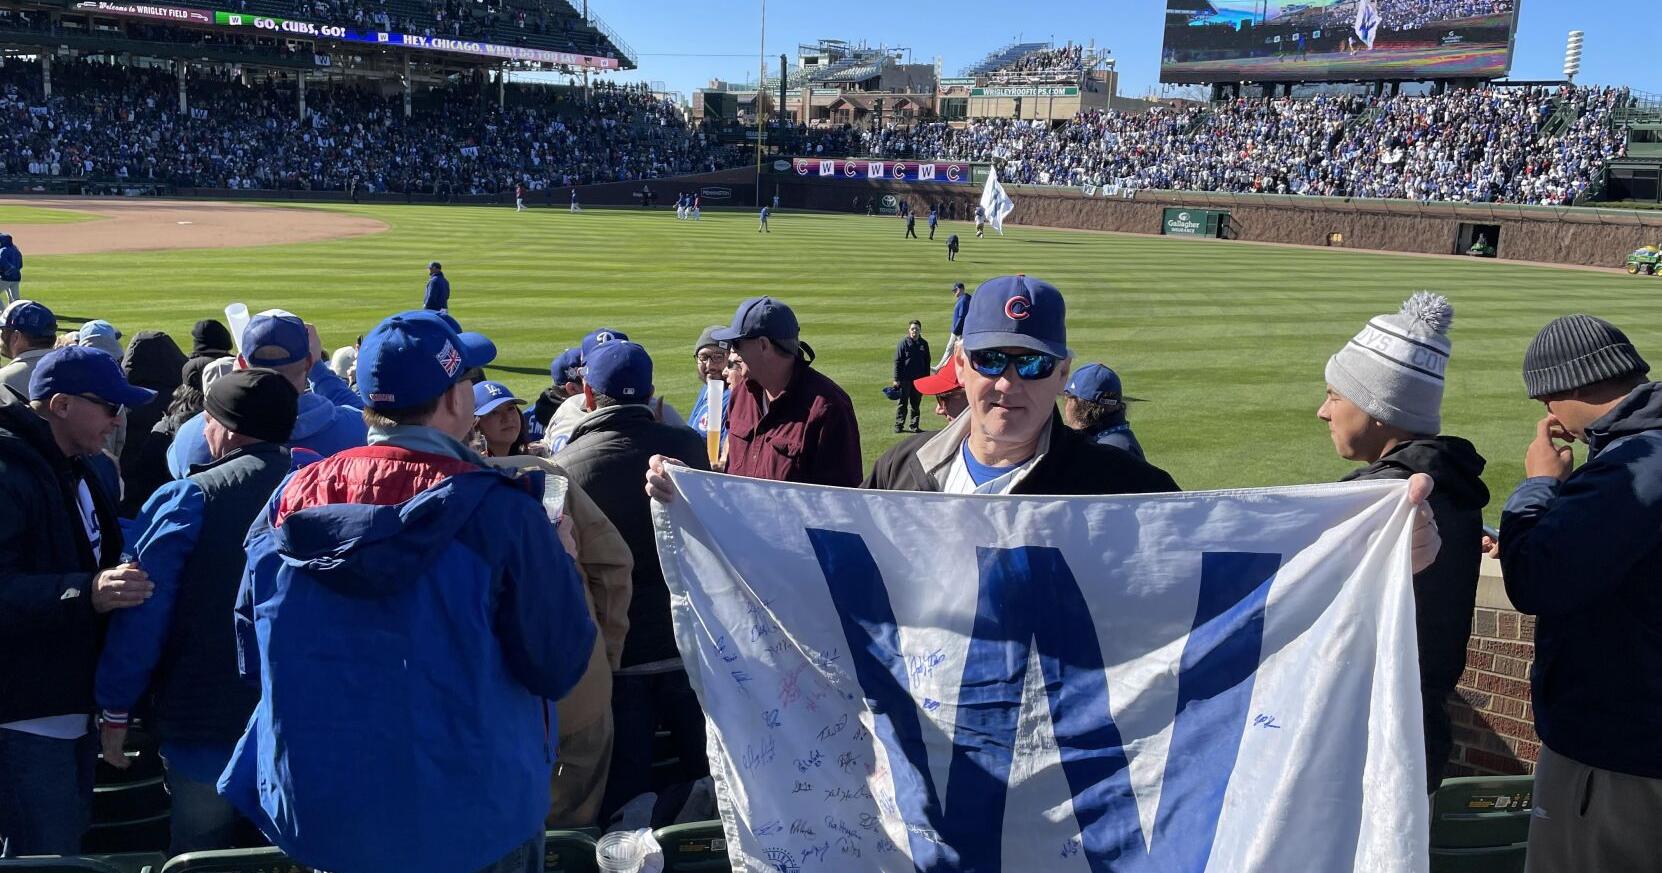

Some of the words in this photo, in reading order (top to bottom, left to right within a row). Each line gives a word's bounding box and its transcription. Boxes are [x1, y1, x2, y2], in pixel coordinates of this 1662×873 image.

[99, 2, 127, 12] Welcome
[137, 6, 167, 16] WRIGLEY
[168, 9, 188, 18] FIELD
[254, 18, 279, 31] GO,
[282, 21, 318, 35] CUBS,
[321, 26, 346, 37] GO!
[403, 35, 429, 48] HEY,
[486, 44, 518, 58] WHAT
[983, 87, 1066, 96] WRIGLEYROOFTOPS.COM
[192, 109, 207, 119] W
[796, 160, 809, 175] C
[822, 161, 833, 173] W
[844, 161, 857, 177] C
[871, 164, 883, 177] W
[892, 163, 906, 179] C
[921, 165, 933, 179] W
[946, 165, 960, 181] C
[1168, 220, 1200, 228] Gallagher
[1005, 296, 1031, 320] C
[805, 527, 1283, 873] W
